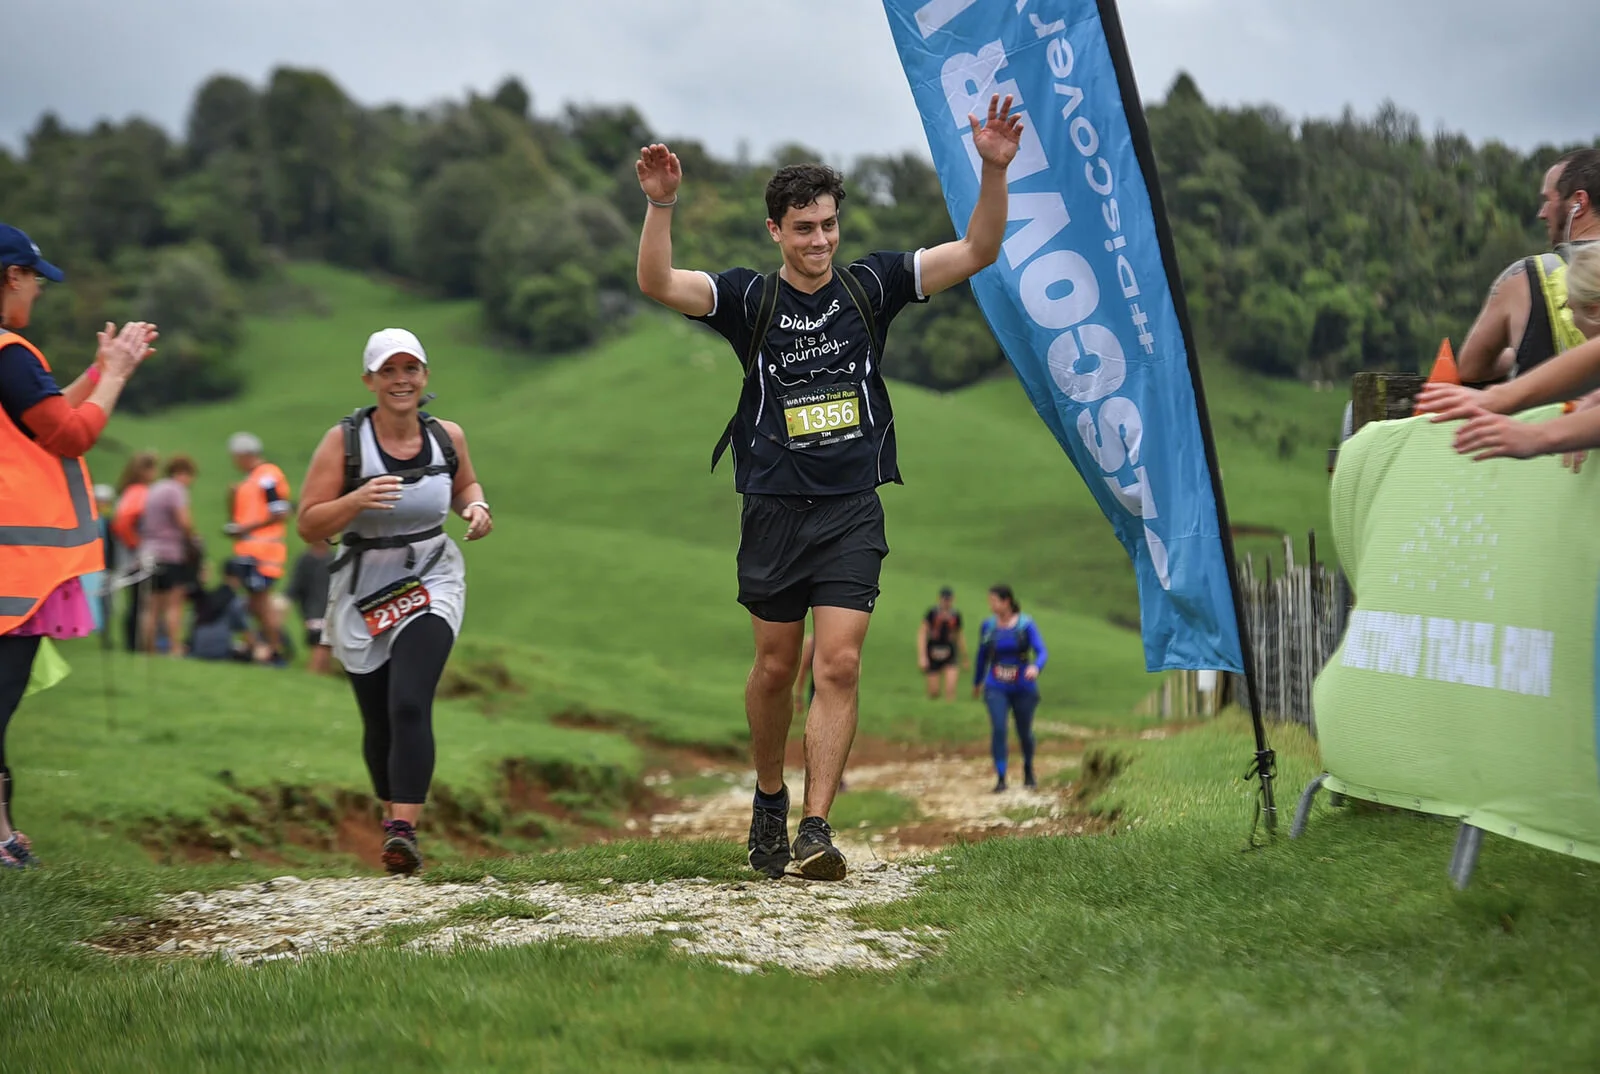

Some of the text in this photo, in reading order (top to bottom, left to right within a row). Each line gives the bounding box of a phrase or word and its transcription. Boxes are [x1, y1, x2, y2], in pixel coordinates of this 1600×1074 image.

[780, 299, 840, 331] Diabetes
[780, 339, 849, 368] journey...
[795, 332, 827, 350] it's a
[826, 391, 842, 401] Trail
[842, 390, 856, 398] Run
[797, 401, 855, 431] 1356
[373, 590, 427, 629] 2195
